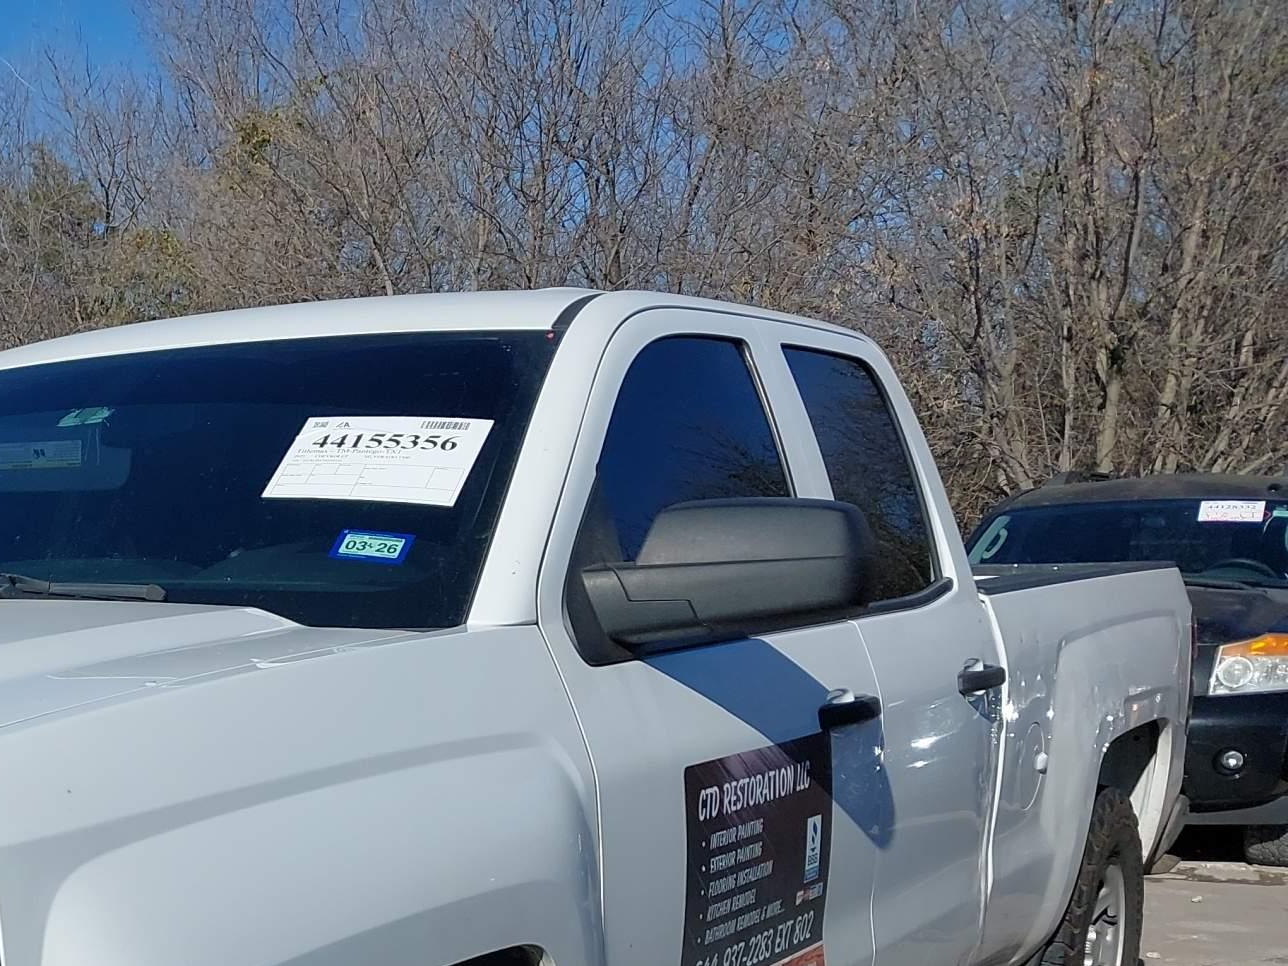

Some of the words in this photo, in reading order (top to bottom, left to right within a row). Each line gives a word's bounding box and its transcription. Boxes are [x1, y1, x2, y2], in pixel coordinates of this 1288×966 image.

[312, 433, 462, 451] 44155356
[698, 785, 720, 821] CTD
[722, 764, 795, 816] RESTORATION
[796, 760, 812, 791] LLC
[774, 919, 795, 954] EXT
[793, 910, 814, 945] 802
